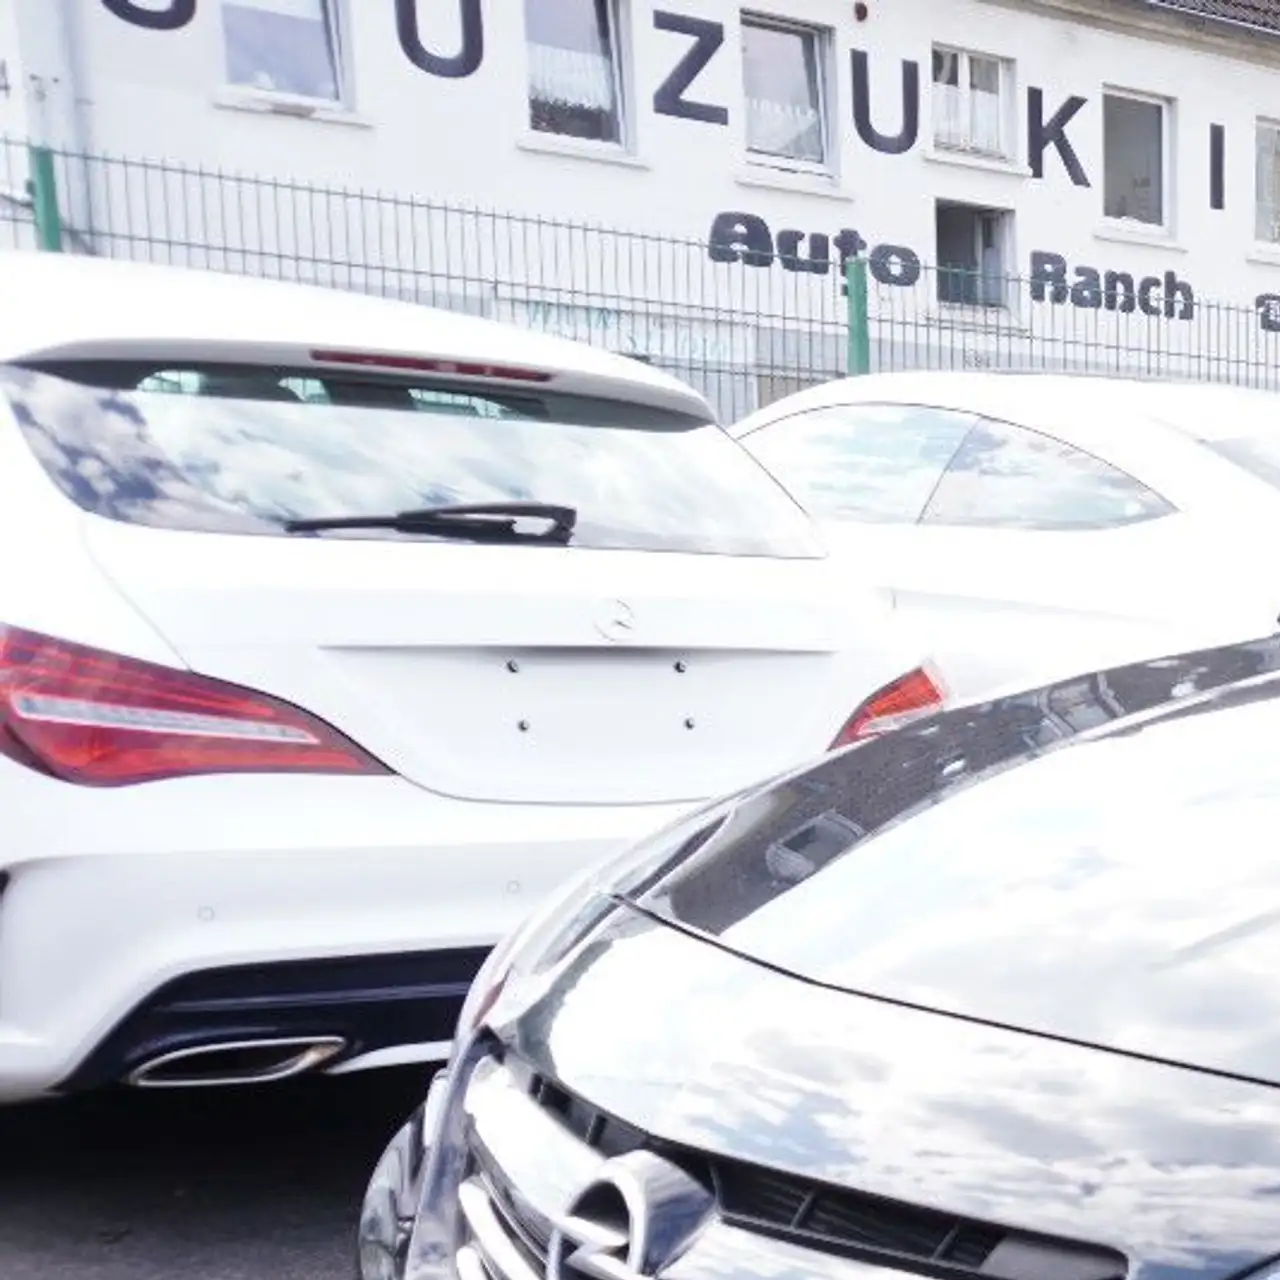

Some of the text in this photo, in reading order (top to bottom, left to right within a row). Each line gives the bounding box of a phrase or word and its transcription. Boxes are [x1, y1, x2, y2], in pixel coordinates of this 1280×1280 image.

[101, 0, 1225, 210] UZUKI
[708, 210, 1194, 320] Auto Ranch
